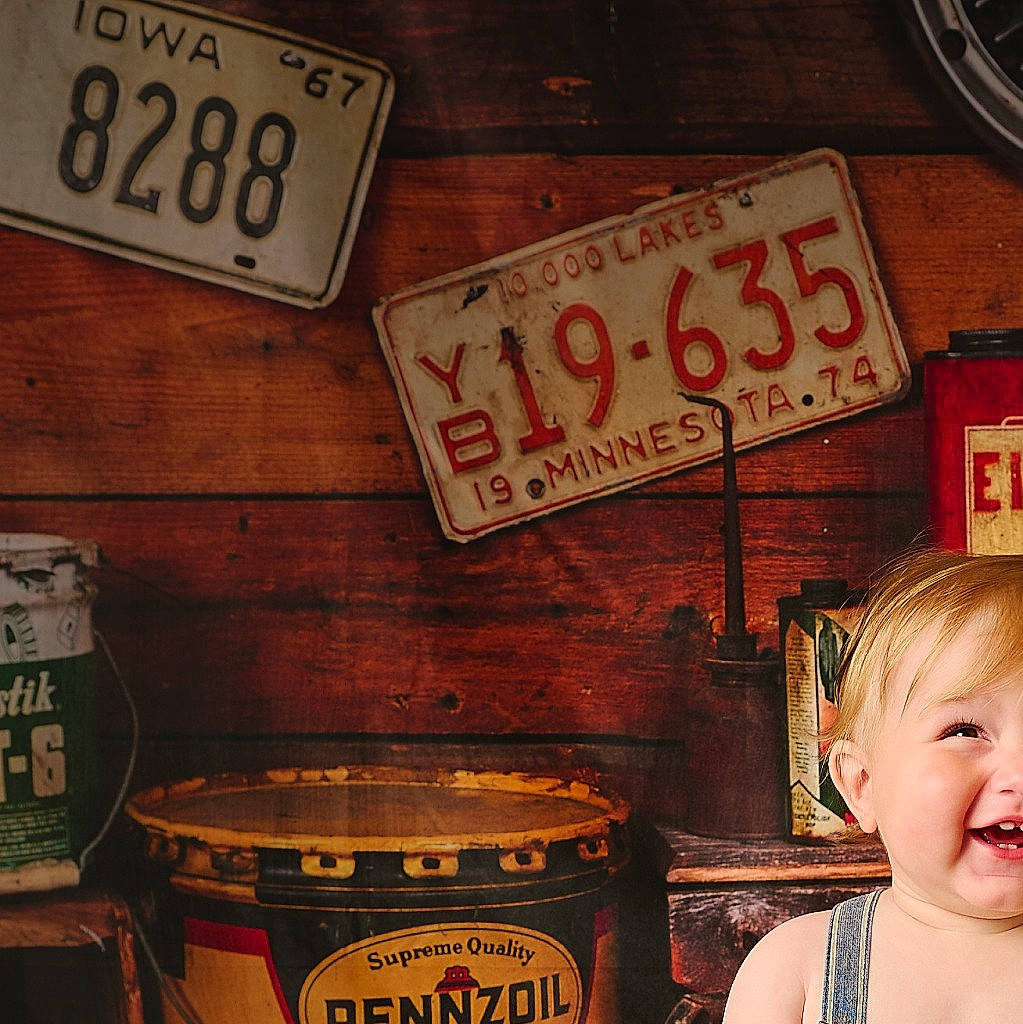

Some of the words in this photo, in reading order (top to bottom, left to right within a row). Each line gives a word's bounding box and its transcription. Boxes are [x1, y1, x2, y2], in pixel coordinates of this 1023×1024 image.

[74, 0, 222, 70] IOWA
[59, 65, 297, 238] 8288
[613, 201, 724, 263] LAKES
[473, 475, 514, 511] 19
[543, 383, 796, 489] MINNESOTA
[818, 354, 878, 399] 74
[367, 941, 463, 971] Supreme
[467, 937, 536, 966] Quality
